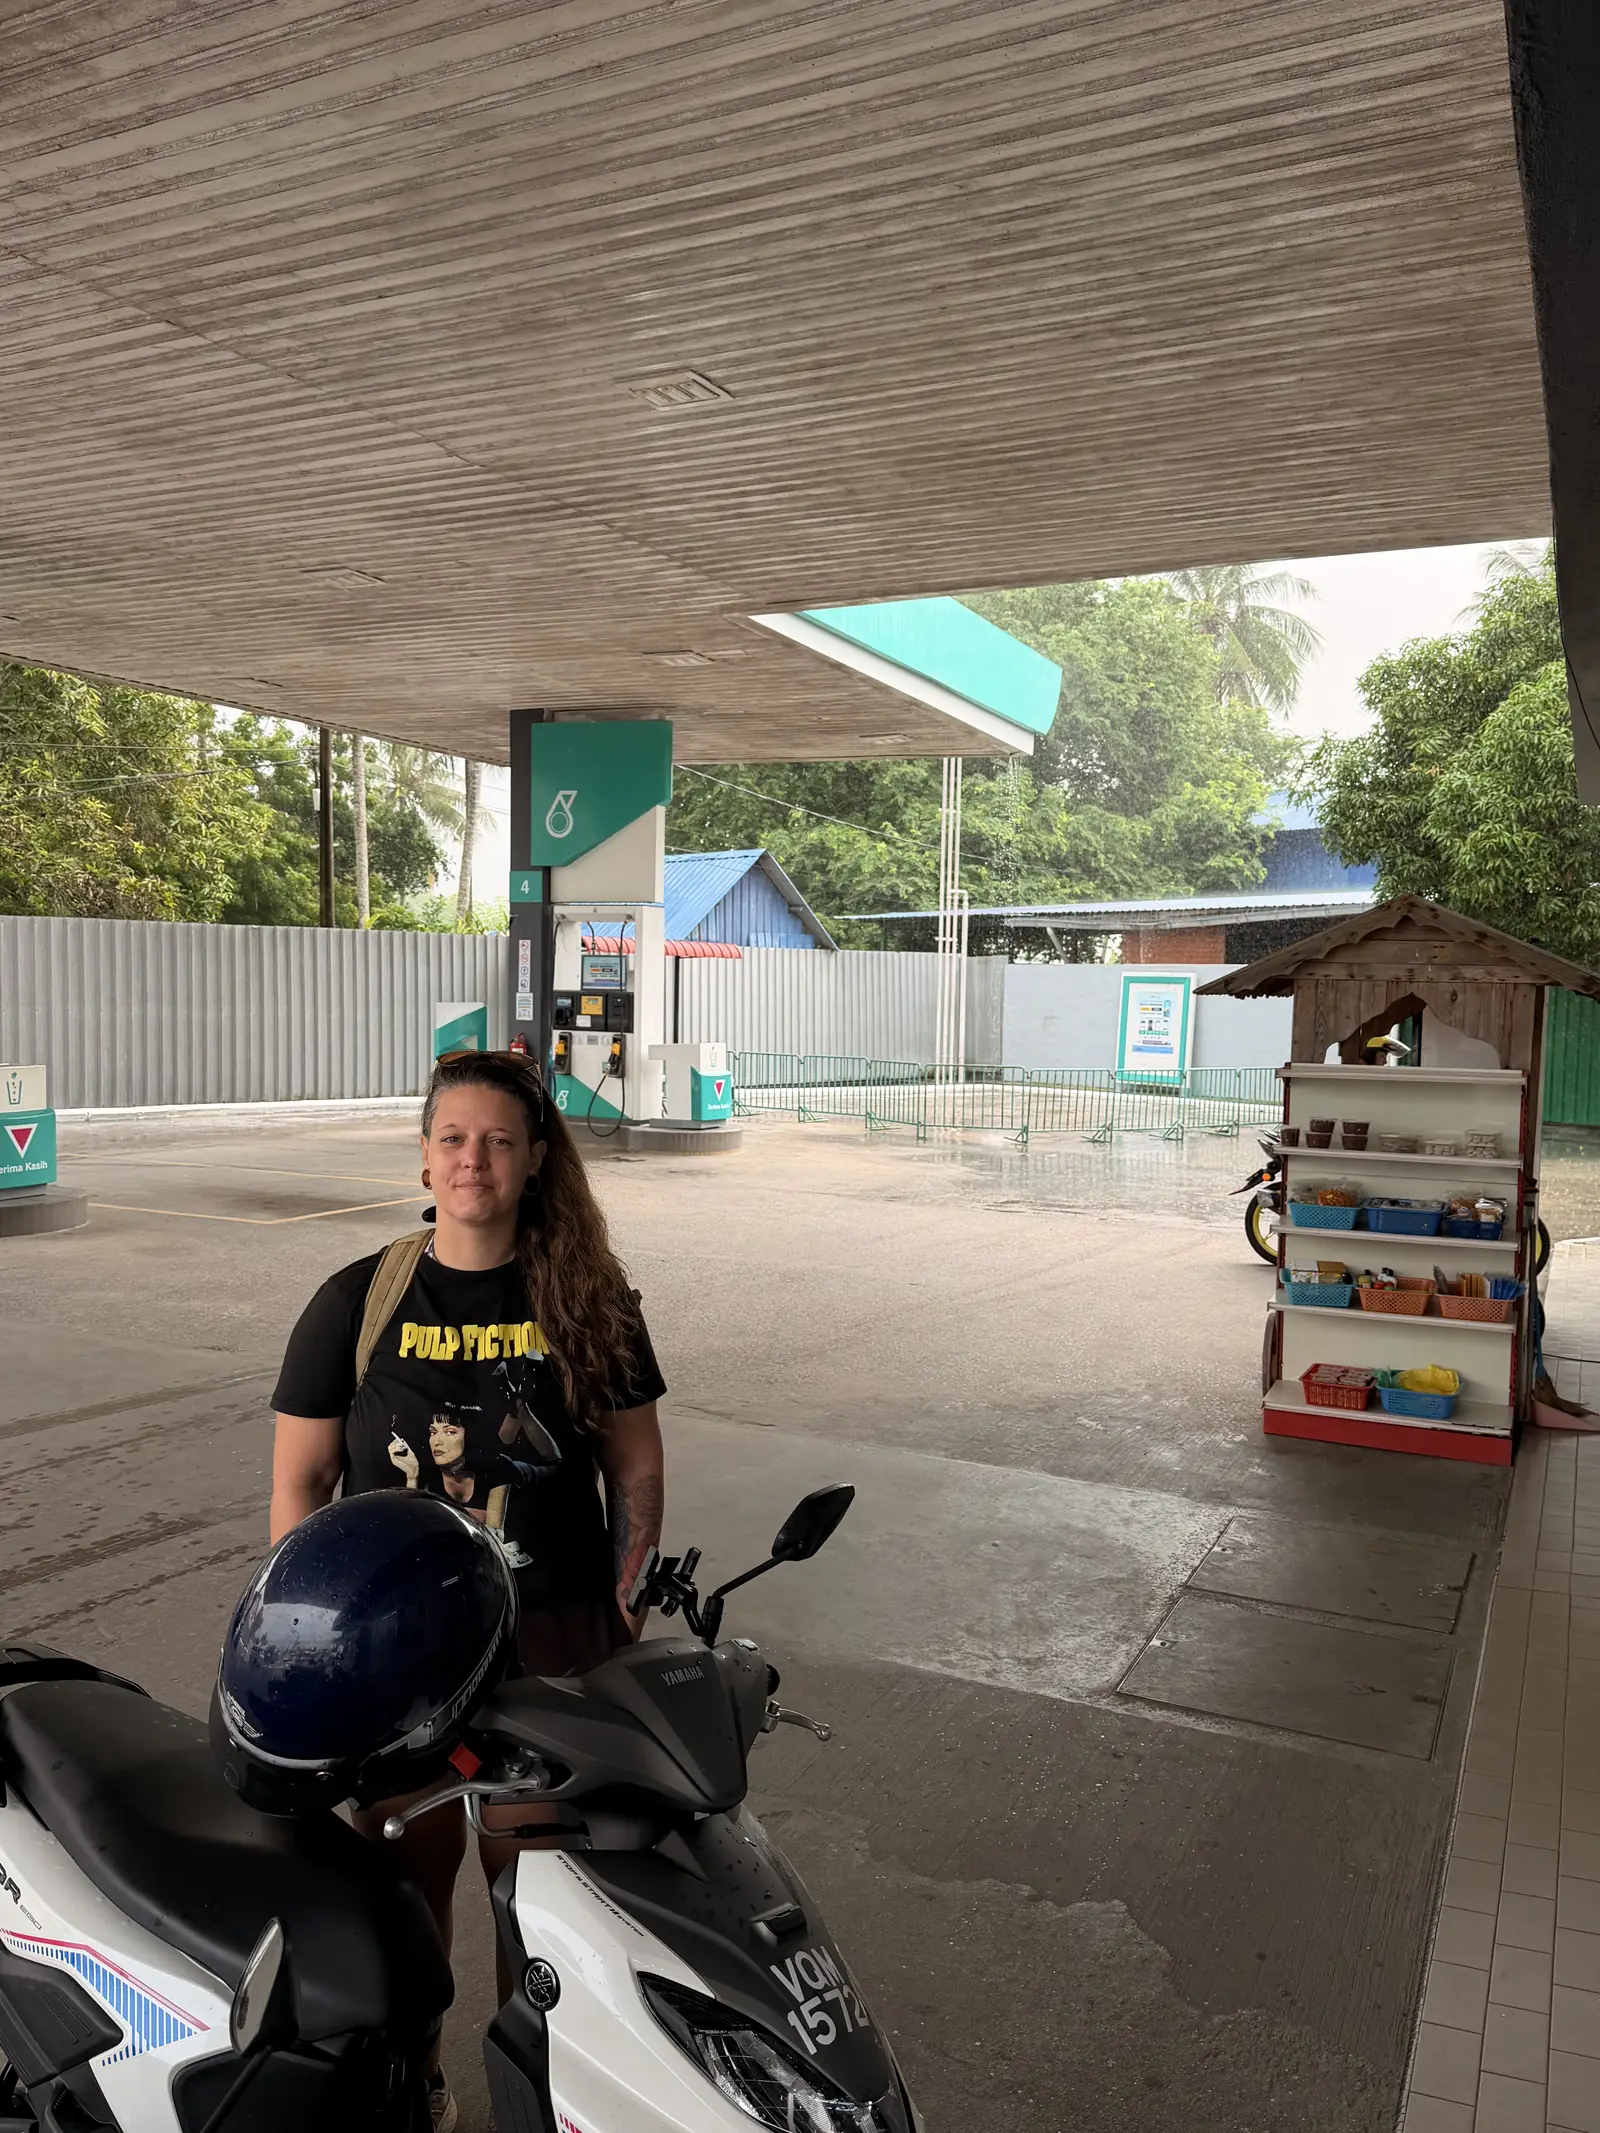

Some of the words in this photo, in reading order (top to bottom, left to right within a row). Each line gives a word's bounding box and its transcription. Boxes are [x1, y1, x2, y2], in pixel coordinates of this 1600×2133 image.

[520, 880, 530, 894] 4
[0, 1164, 24, 1174] erima
[25, 1160, 48, 1171] Kasih
[398, 1322, 461, 1361] PULP
[660, 1665, 704, 1686] YAMAHA
[556, 1854, 578, 1875] STOP
[581, 1881, 612, 1908] START
[769, 1945, 846, 2003] VQM
[787, 1984, 870, 2055] 1572
